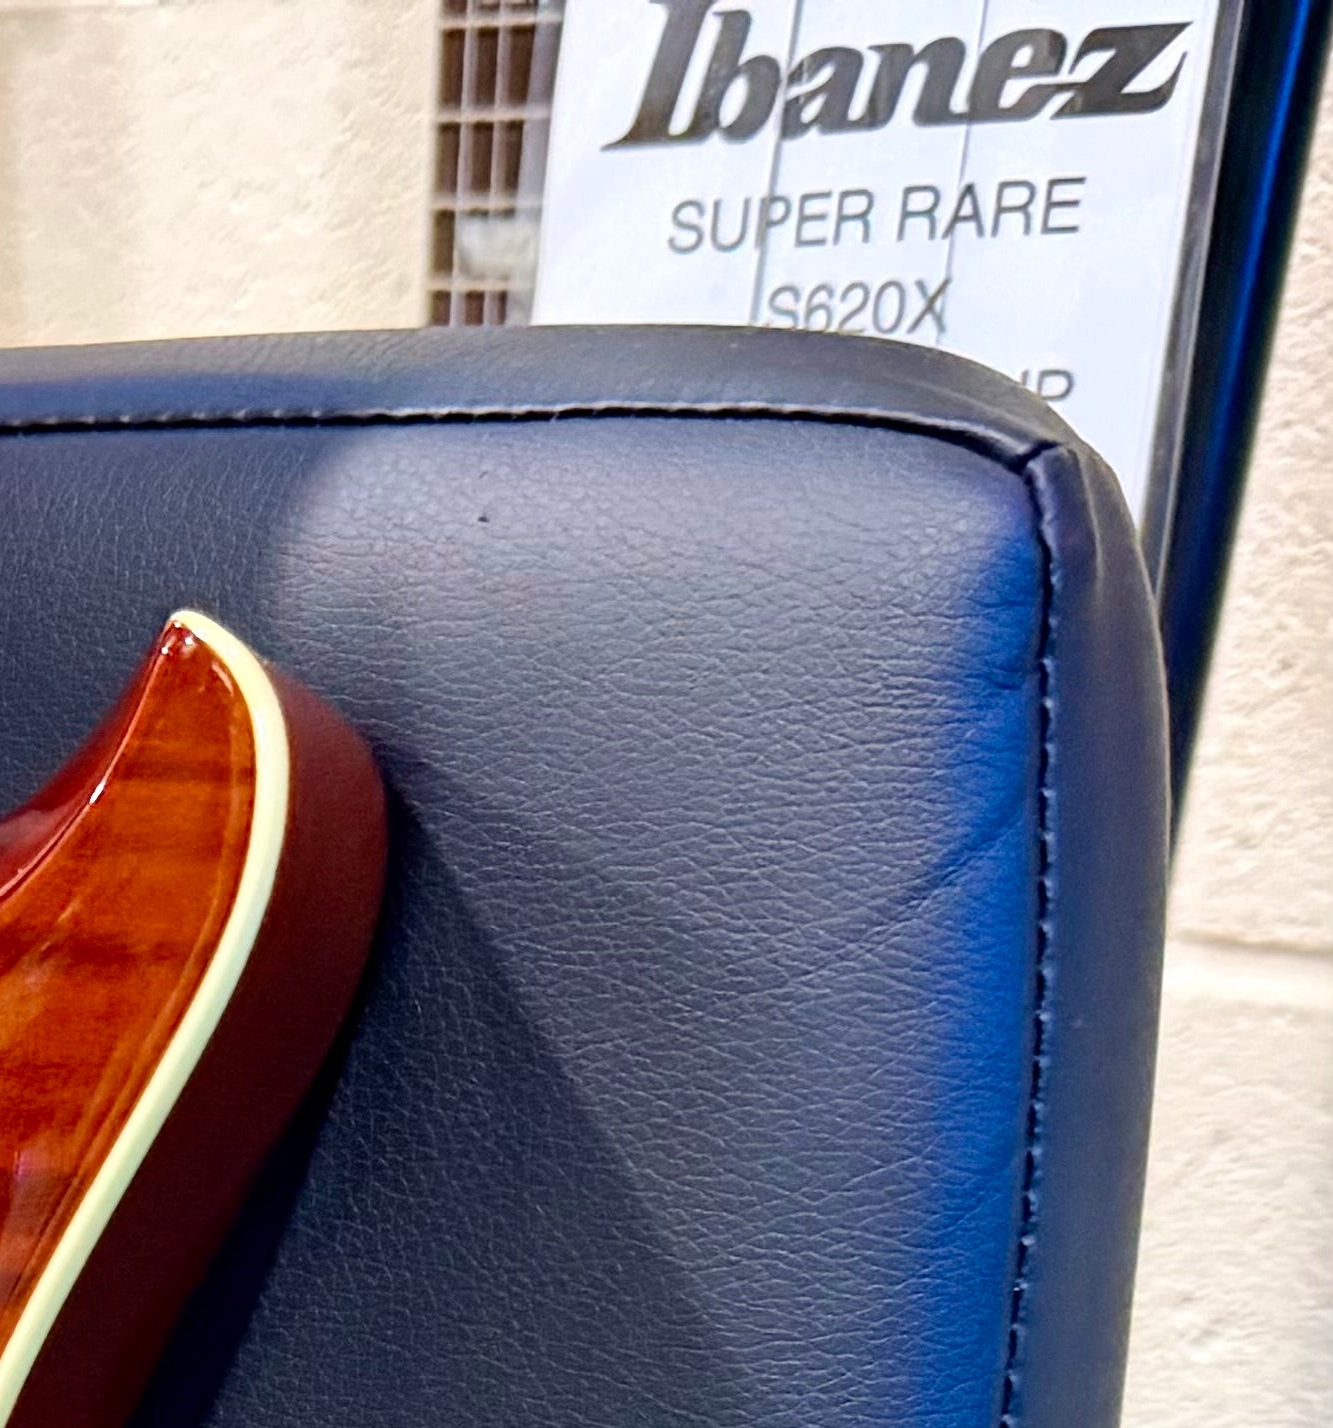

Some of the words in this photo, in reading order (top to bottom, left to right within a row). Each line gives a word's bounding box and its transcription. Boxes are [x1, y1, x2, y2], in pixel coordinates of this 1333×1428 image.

[599, 0, 1192, 151] Ibanez
[669, 189, 872, 253] SUPER
[897, 176, 1086, 243] RARE
[768, 276, 952, 336] S620X
